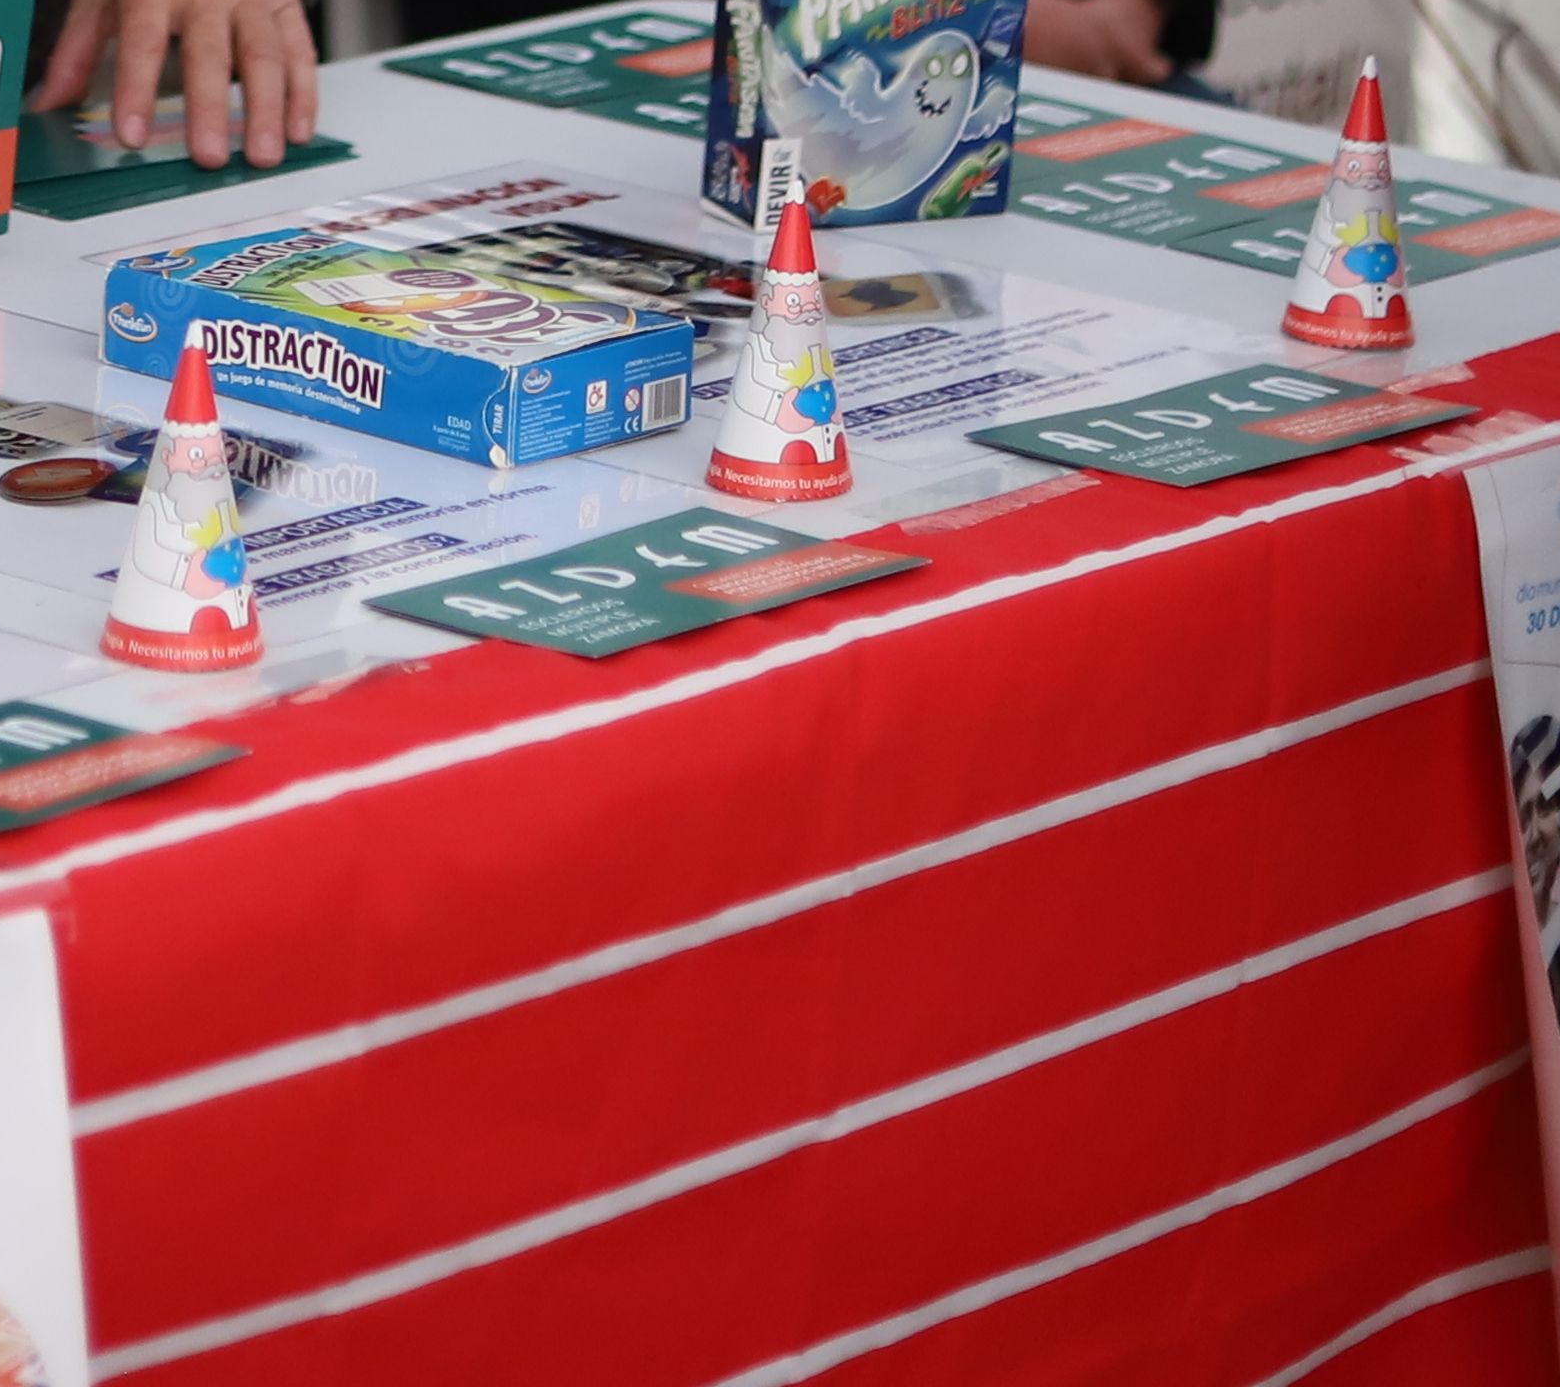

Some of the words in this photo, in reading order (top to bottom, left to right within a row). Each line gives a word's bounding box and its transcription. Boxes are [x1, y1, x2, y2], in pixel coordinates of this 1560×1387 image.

[201, 322, 381, 409] DISTRACTION
[230, 373, 252, 387] juego
[255, 376, 265, 387] de
[268, 378, 303, 396] memoria
[447, 416, 472, 430] EDAD
[493, 404, 504, 434] TIRAR
[724, 468, 796, 490] Necesitamos
[799, 478, 811, 488] tu
[1526, 609, 1546, 634] 30
[129, 640, 209, 661] Necesitamos
[212, 646, 224, 659] tu
